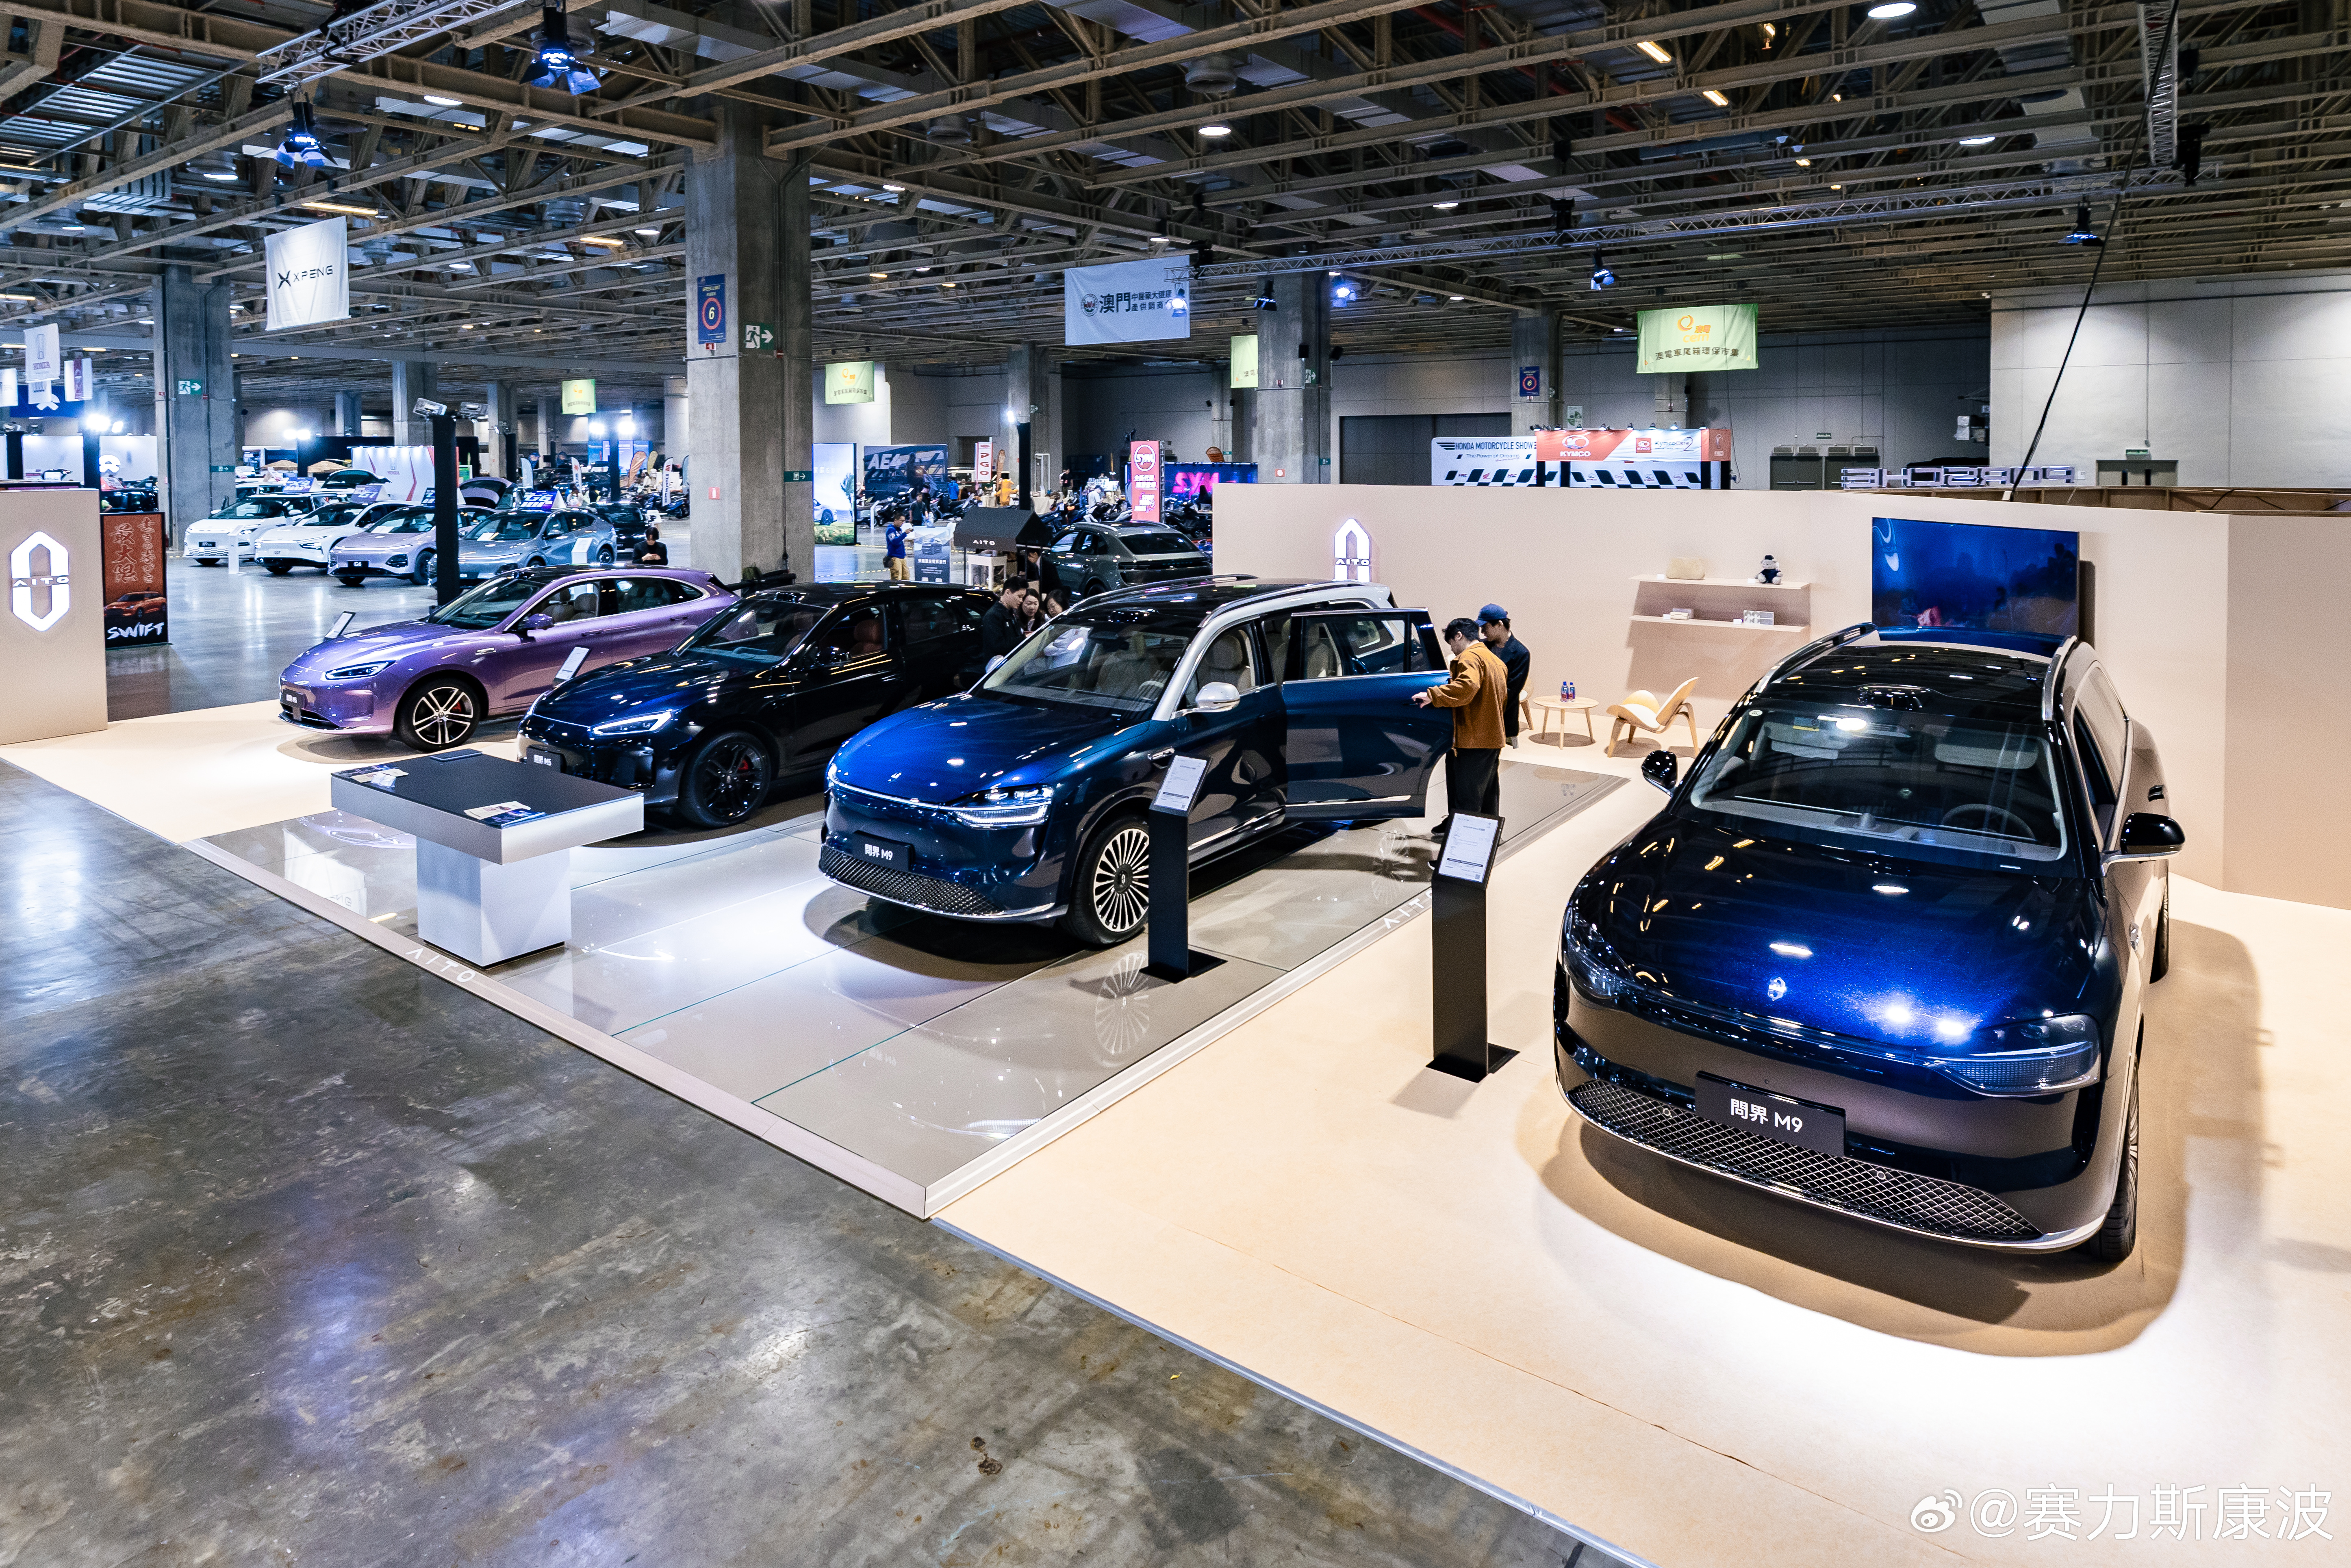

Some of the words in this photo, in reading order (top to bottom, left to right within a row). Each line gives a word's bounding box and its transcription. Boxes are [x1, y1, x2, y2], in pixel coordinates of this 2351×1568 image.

[293, 265, 333, 282] XPENG
[1099, 292, 1131, 313] 澳門
[1132, 301, 1172, 312] 產供銷商
[708, 307, 715, 319] 6
[1683, 333, 1709, 343] cem
[1655, 347, 1739, 360] 澳電車尾箱環保市集
[1476, 442, 1514, 450] MOTORCYCLE
[979, 453, 990, 475] PGO
[1135, 453, 1154, 465] SYM
[1172, 472, 1219, 499] SYM
[109, 523, 138, 583] 最大限
[13, 576, 69, 587] AITO
[107, 622, 165, 640] SWIFT
[864, 844, 880, 858] 問界
[881, 849, 893, 861] M9
[405, 948, 476, 982] AITO
[1730, 1098, 1769, 1124] 問界
[1774, 1112, 1803, 1133] M9
